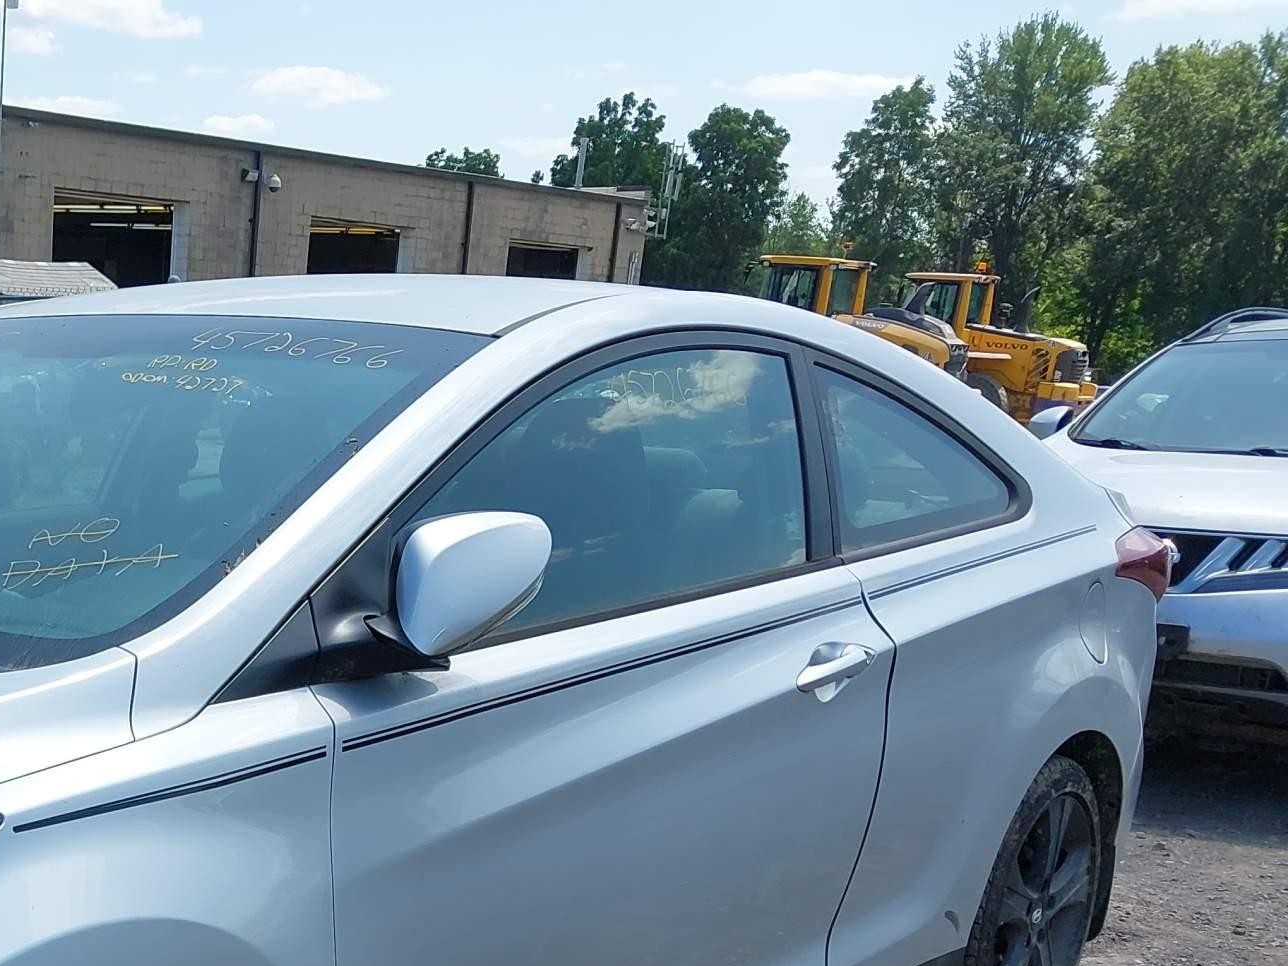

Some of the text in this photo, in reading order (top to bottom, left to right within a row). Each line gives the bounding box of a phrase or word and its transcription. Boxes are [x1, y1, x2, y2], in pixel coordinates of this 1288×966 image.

[191, 327, 405, 368] 45726766
[986, 341, 1029, 351] VOLVO
[28, 518, 121, 549] NO
[2, 543, 180, 592] DATA
